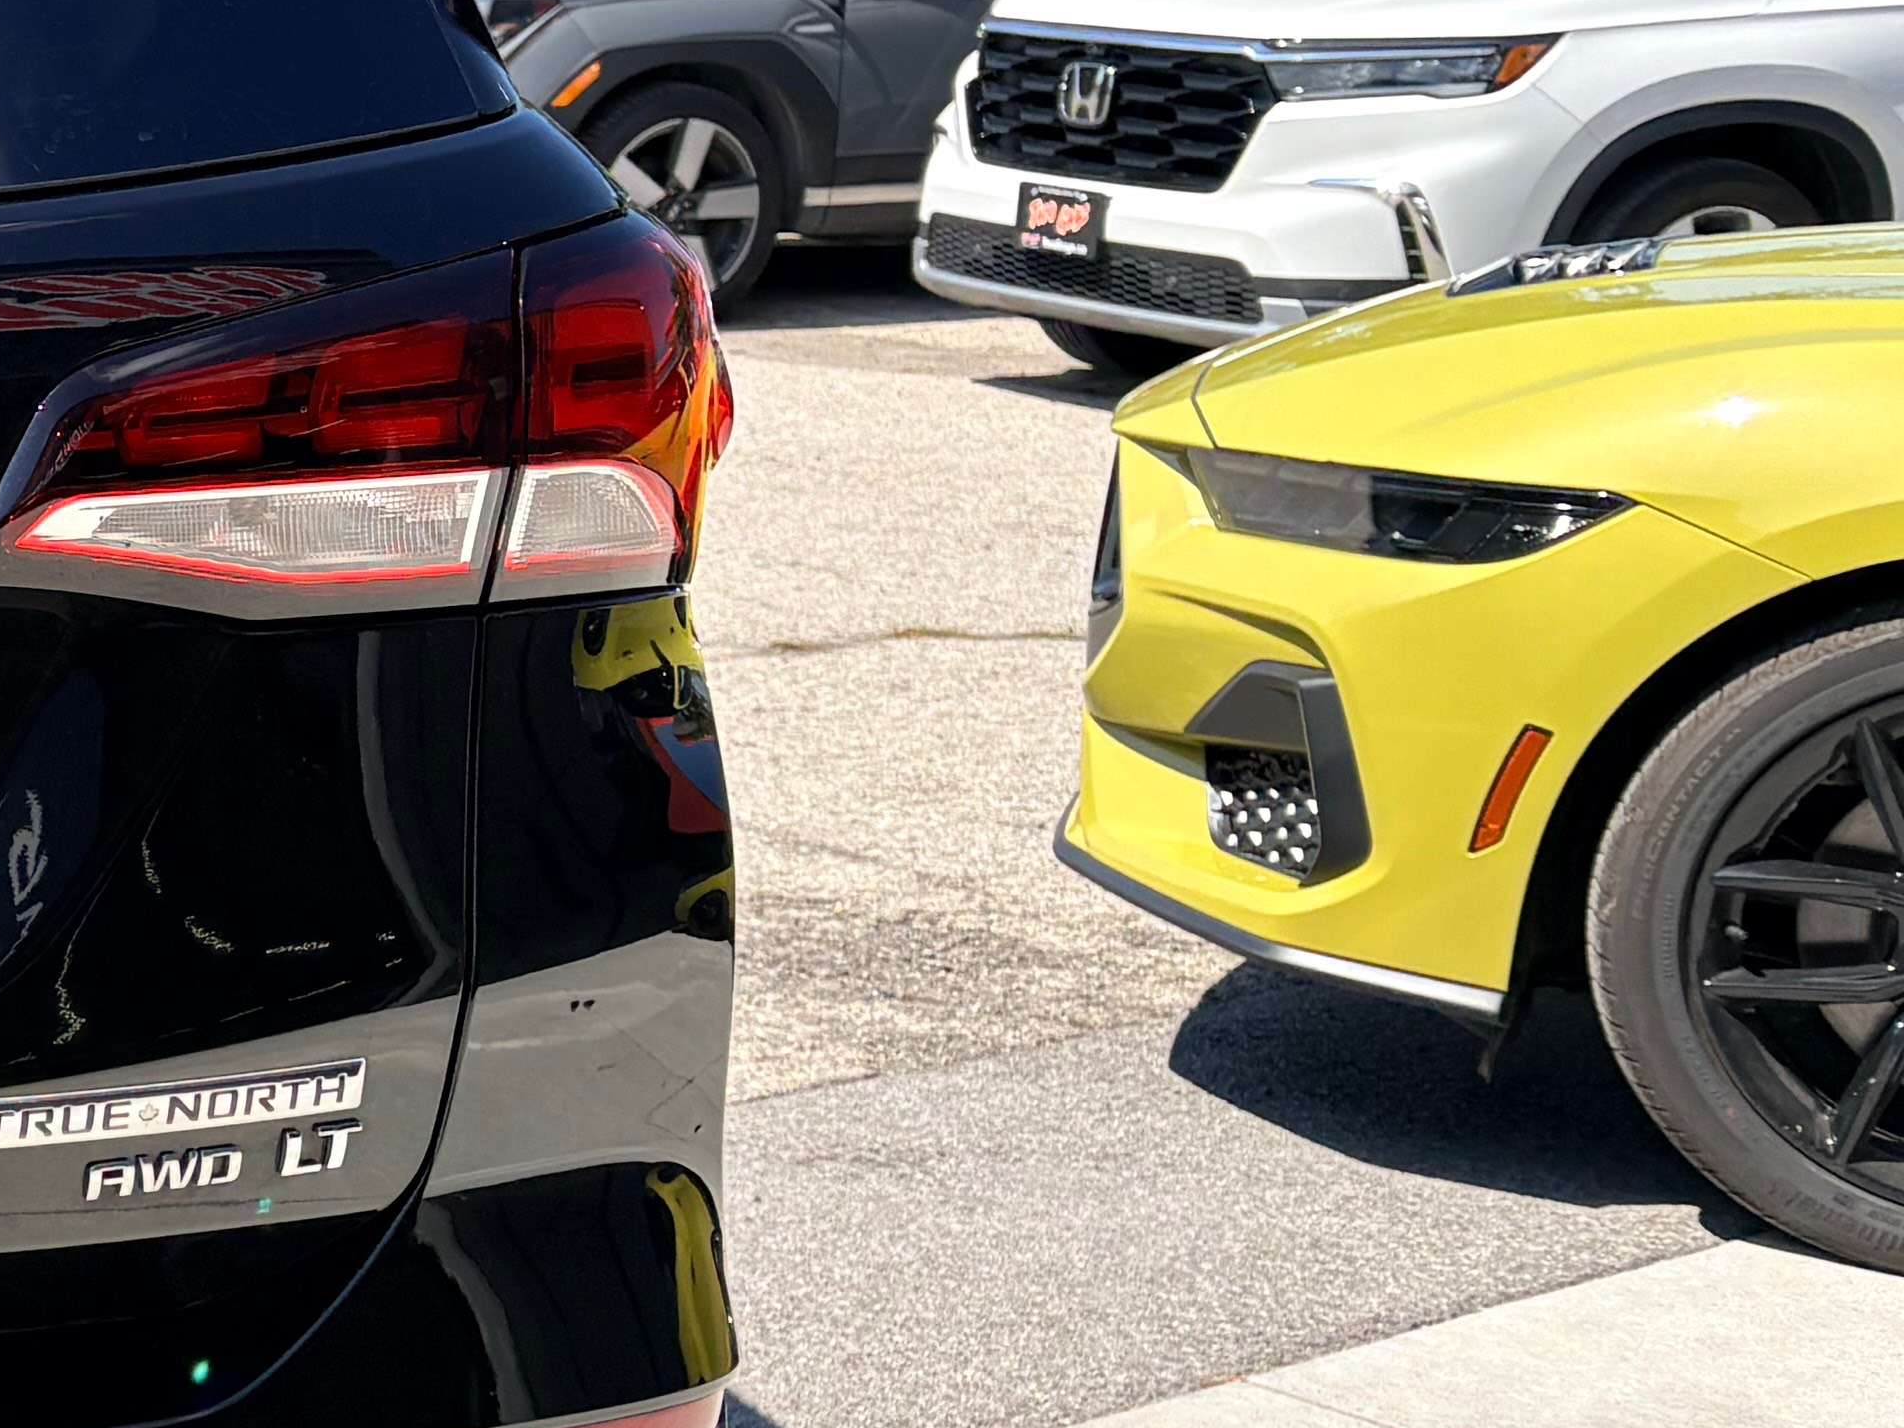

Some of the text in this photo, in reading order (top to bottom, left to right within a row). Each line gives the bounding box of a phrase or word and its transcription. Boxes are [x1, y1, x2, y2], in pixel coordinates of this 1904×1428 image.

[166, 1073, 350, 1126] NORTH
[83, 1117, 364, 1202] AWD LT
